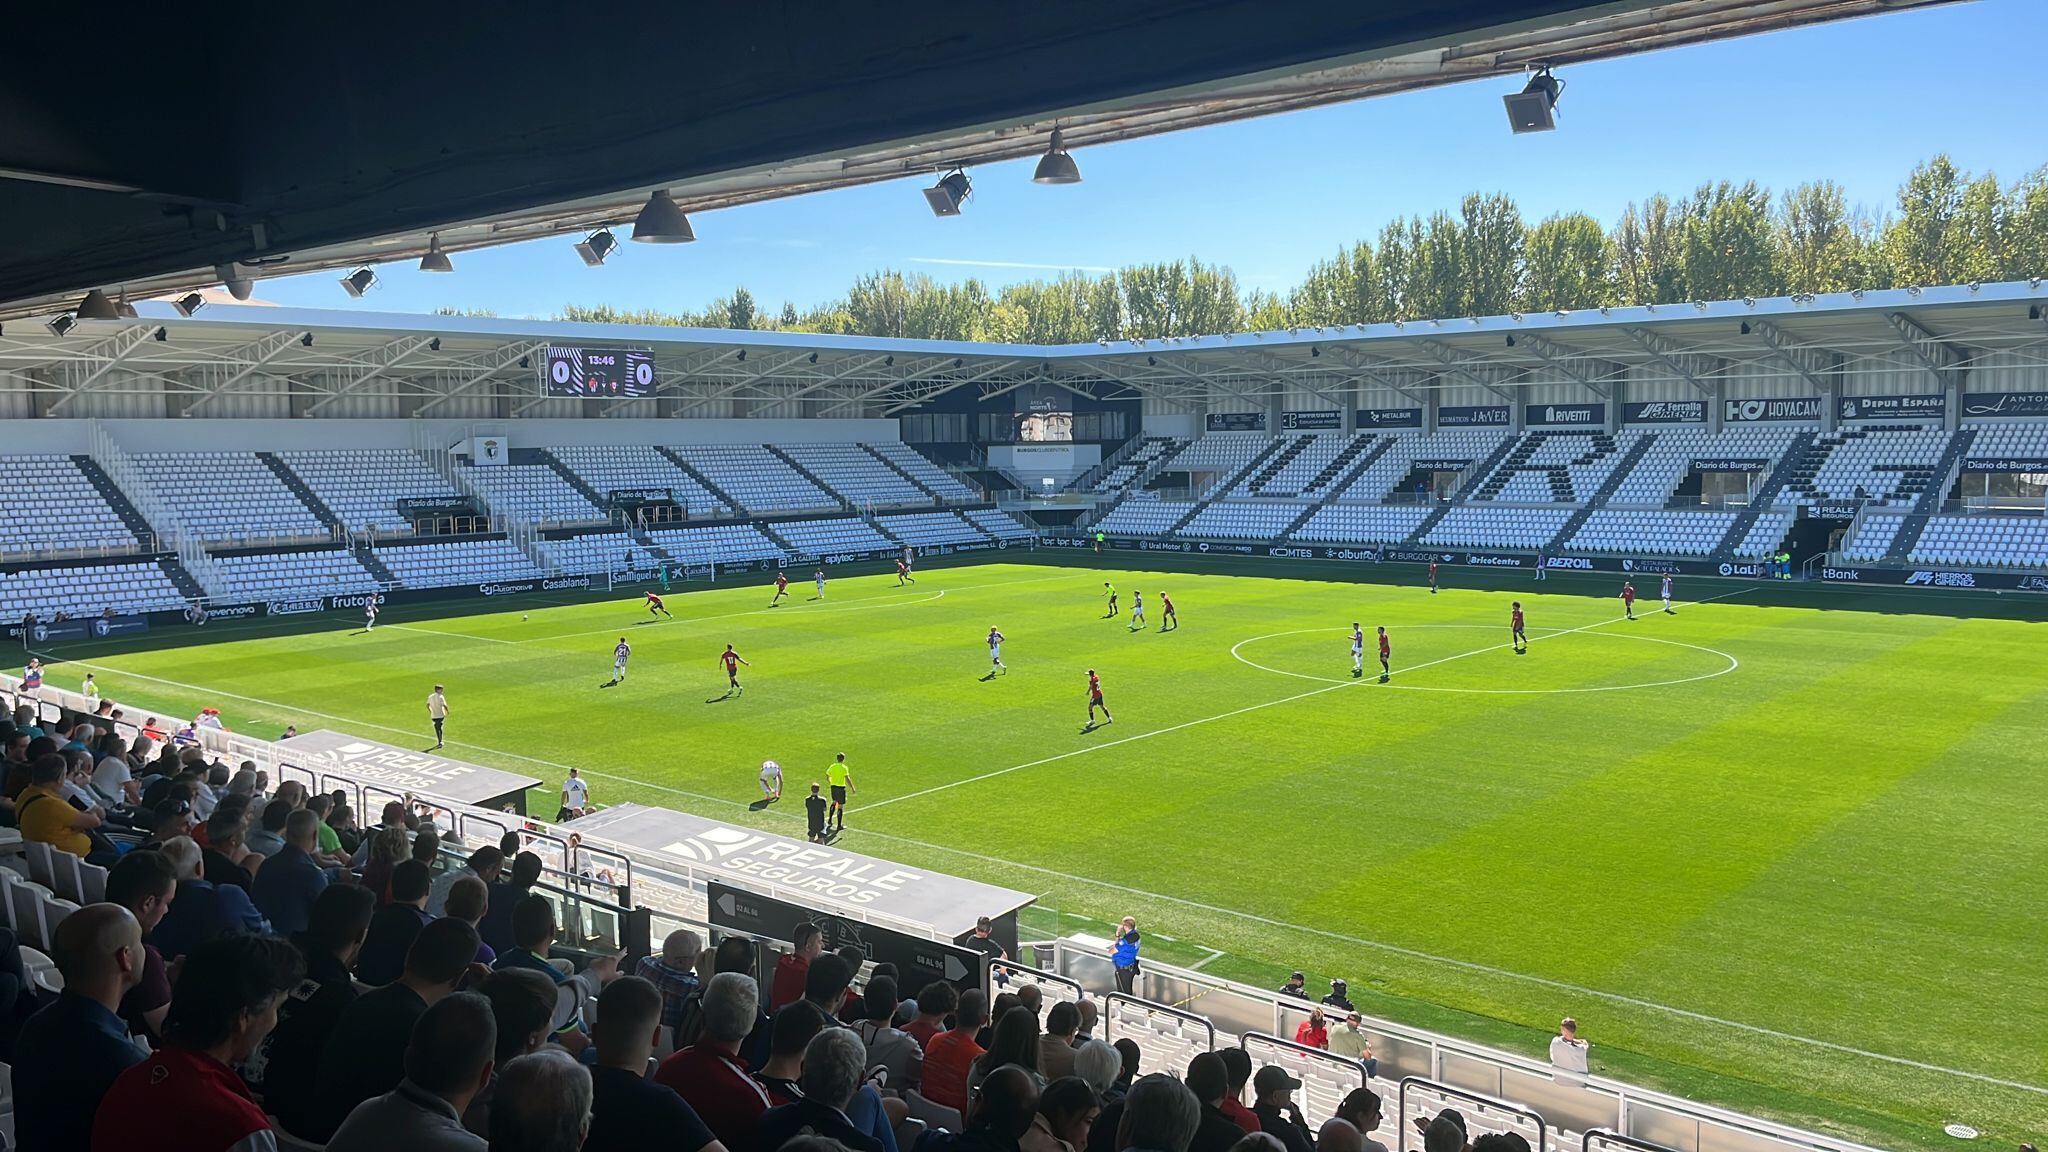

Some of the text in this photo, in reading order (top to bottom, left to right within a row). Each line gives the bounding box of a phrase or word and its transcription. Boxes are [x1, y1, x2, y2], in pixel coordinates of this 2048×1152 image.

[588, 356, 615, 365] 13:46
[552, 361, 570, 384] 0
[636, 363, 653, 385] 0
[1667, 402, 1702, 411] Ferralla
[1696, 461, 1717, 469] Diario
[1719, 461, 1729, 469] de
[1968, 461, 1994, 469] Diario
[1996, 461, 2008, 469] de
[427, 499, 434, 507] de
[825, 553, 855, 565] aplytec
[1398, 552, 1439, 561] BURGOCAR
[1471, 556, 1521, 566] BricoCentro
[1546, 557, 1593, 569] BEROIL
[1935, 572, 1973, 580] HIERROS
[543, 578, 590, 590] Casablanca
[618, 648, 627, 656] 21
[728, 657, 734, 665] 11
[370, 747, 476, 780] REALE
[342, 761, 437, 789] SEGUROS
[751, 840, 924, 891] REALE
[721, 856, 883, 903] SEGUROS
[925, 958, 934, 966] AL
